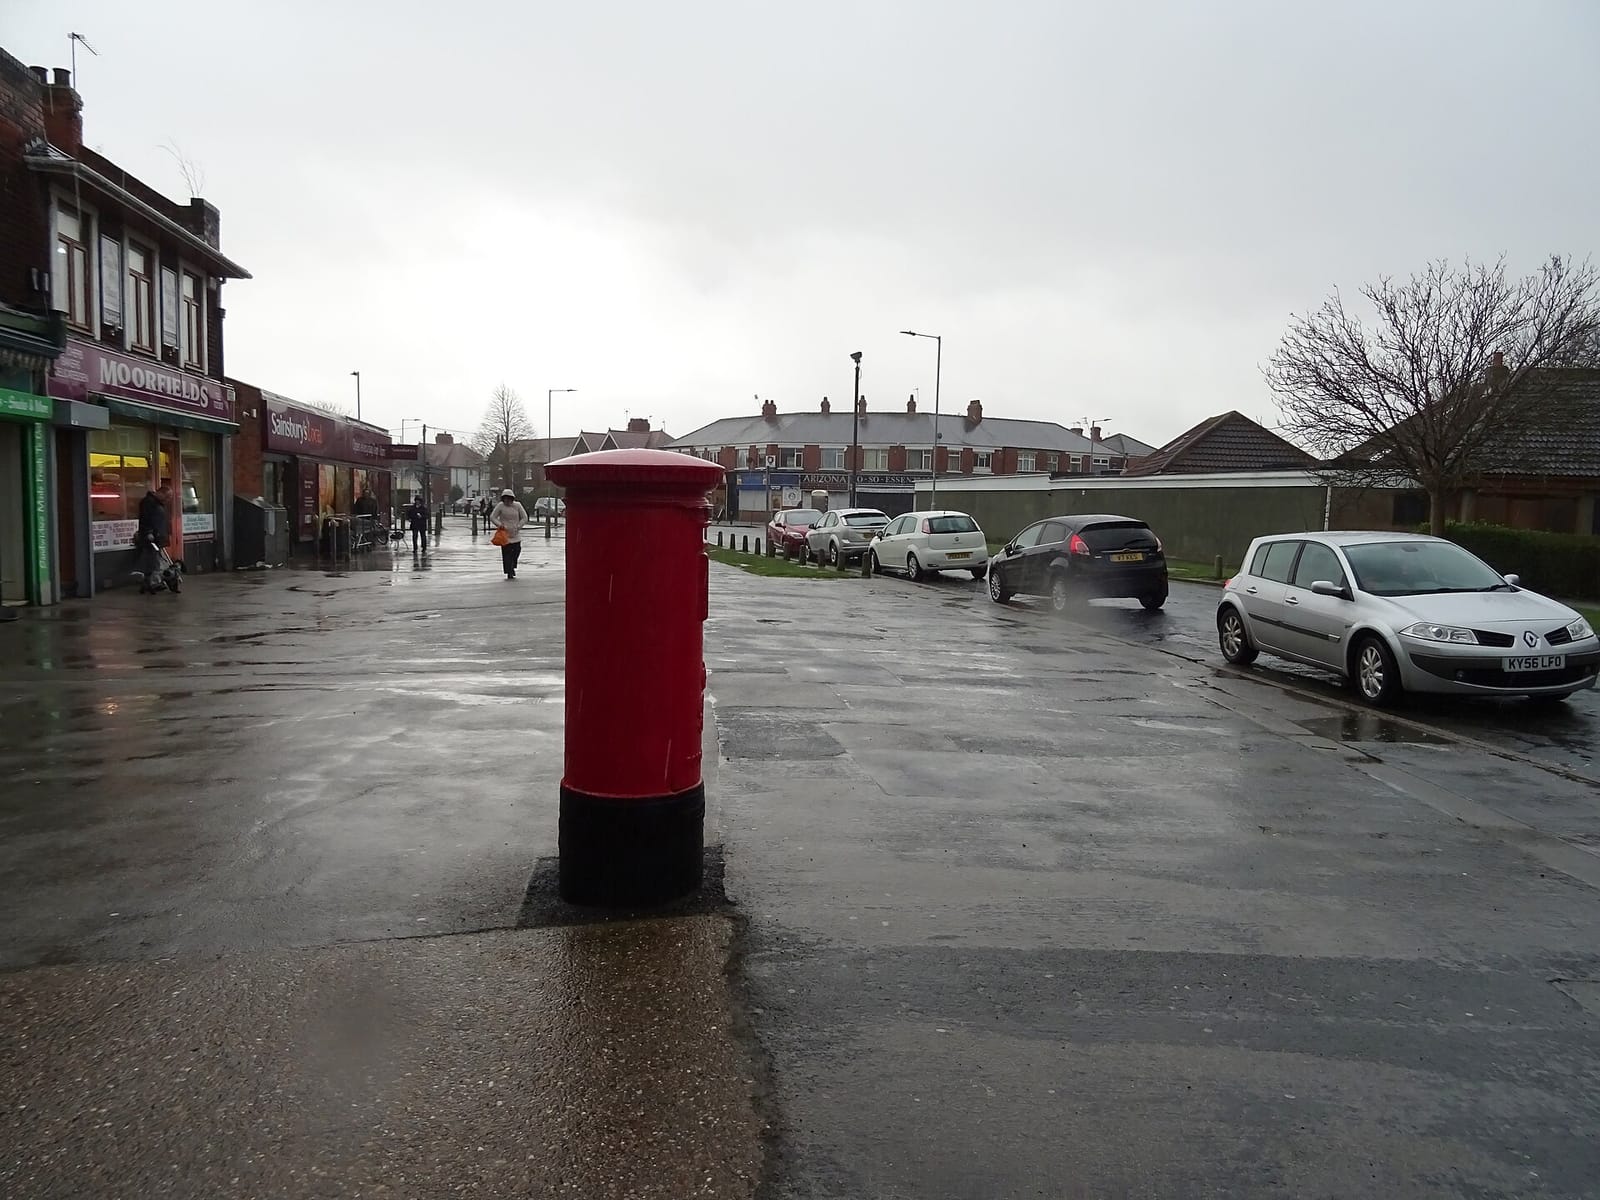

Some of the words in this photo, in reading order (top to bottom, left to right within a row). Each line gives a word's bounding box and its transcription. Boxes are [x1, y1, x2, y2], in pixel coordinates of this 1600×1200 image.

[99, 357, 209, 408] MOORFIELDS
[271, 412, 308, 444] Sainsbury's
[802, 475, 847, 483] ARIZONA
[1508, 657, 1539, 670] KY56
[1541, 655, 1562, 668] LFO
